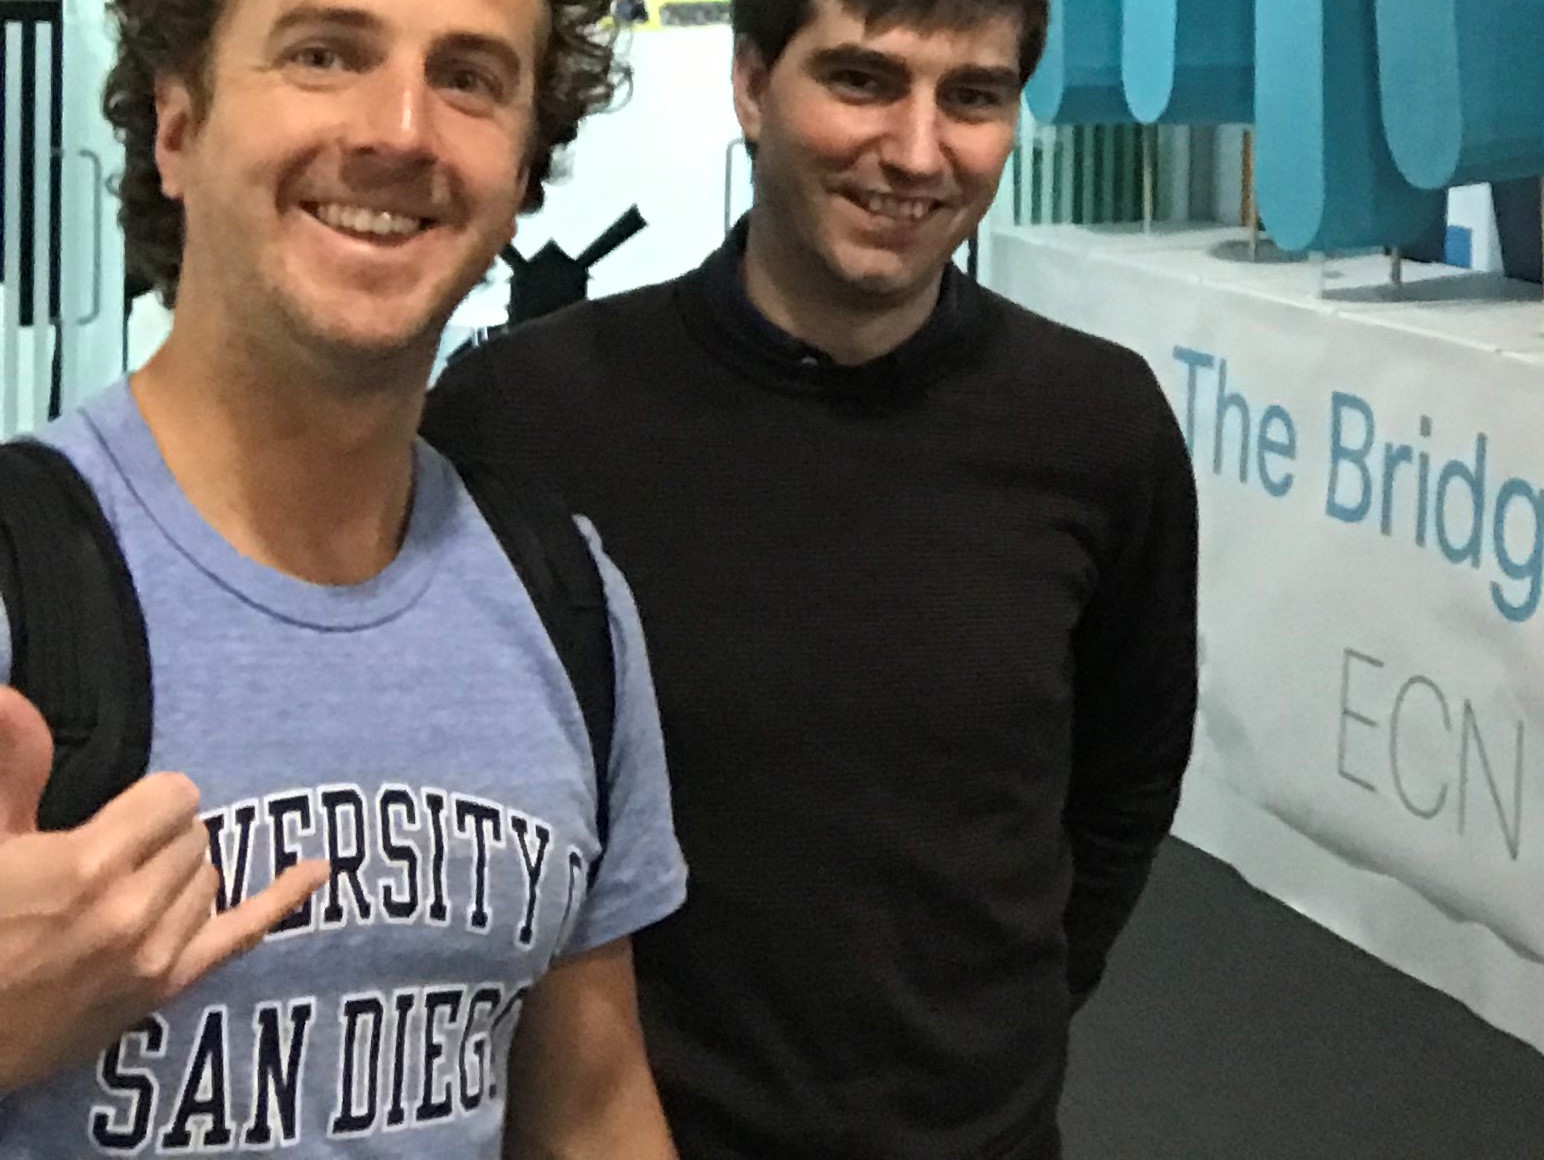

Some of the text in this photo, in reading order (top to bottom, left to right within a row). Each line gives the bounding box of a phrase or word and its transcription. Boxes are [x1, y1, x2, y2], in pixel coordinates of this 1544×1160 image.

[1172, 345, 1297, 498] The
[1336, 647, 1524, 861] ECN
[199, 782, 553, 948] VERSITY
[91, 994, 316, 1155] SAN
